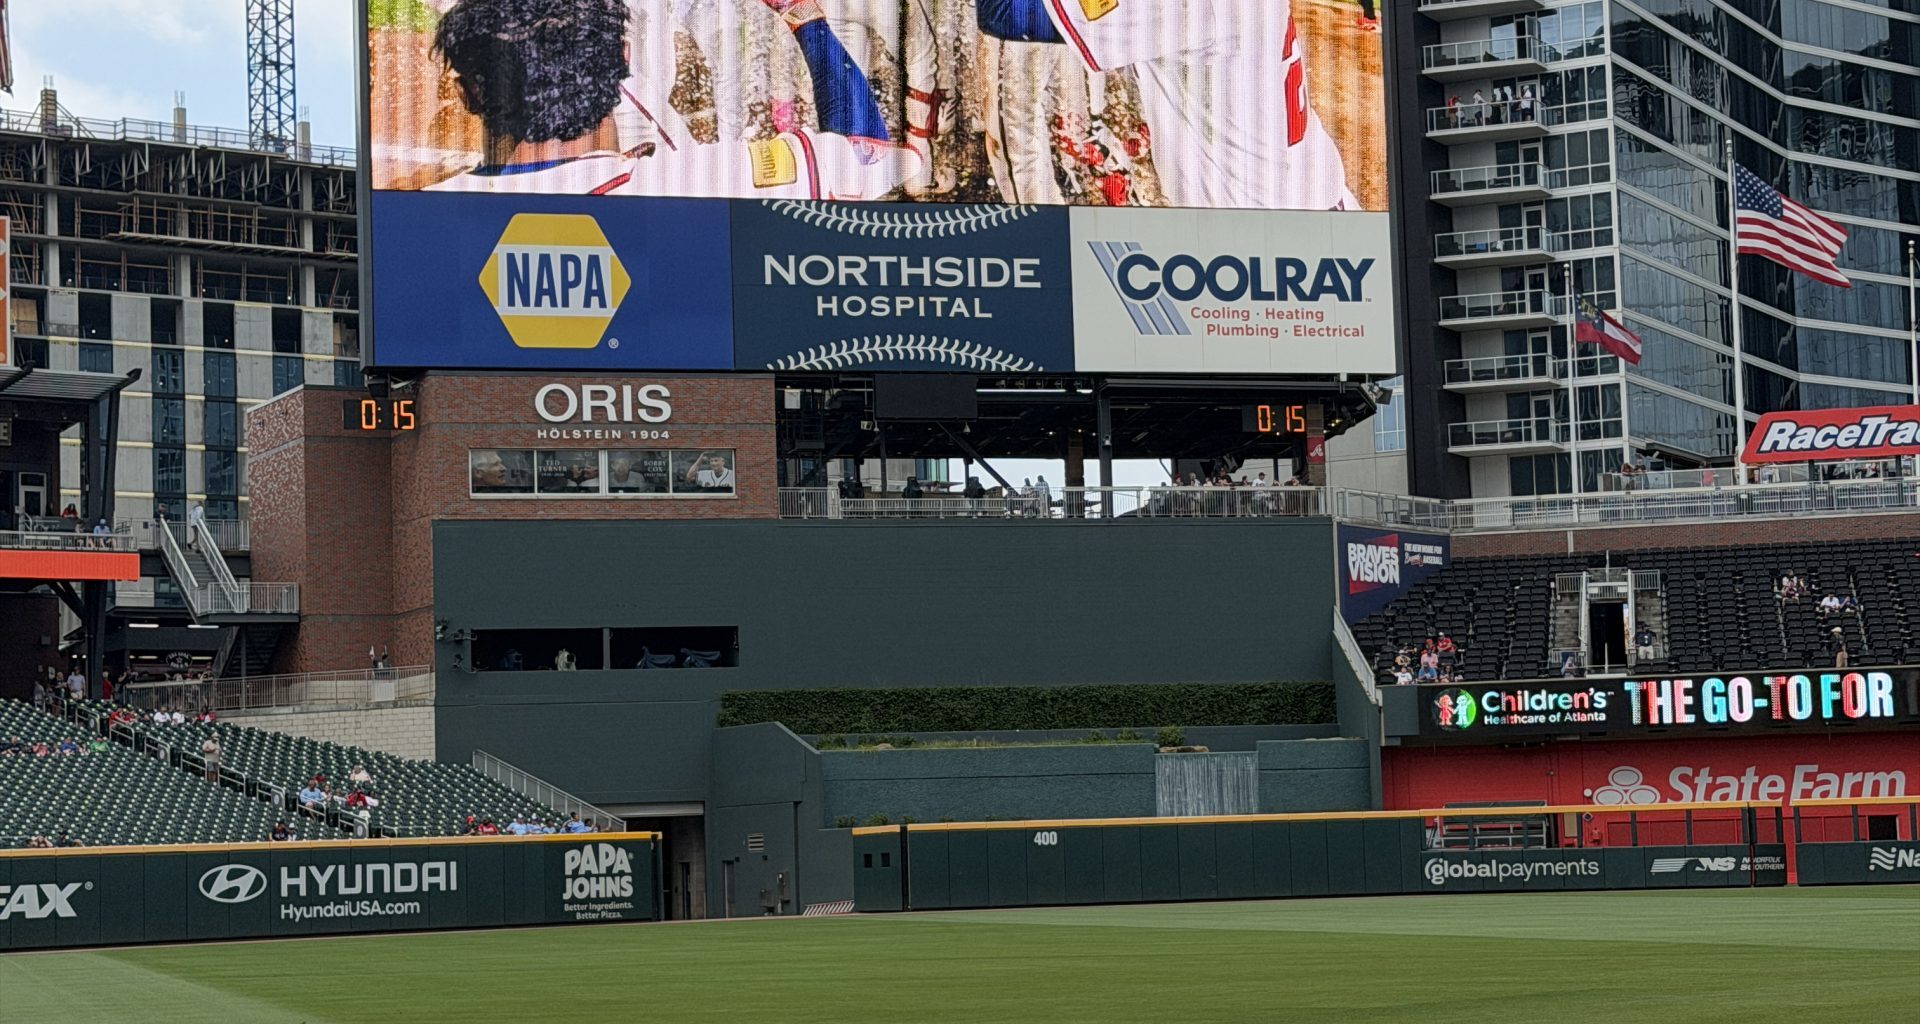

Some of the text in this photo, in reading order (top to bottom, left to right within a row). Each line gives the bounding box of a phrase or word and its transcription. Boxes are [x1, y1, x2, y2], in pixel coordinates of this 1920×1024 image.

[506, 252, 607, 309] NAPA
[764, 254, 1042, 288] NORTHSIDE
[1117, 253, 1376, 302] COOLRAY
[816, 295, 993, 318] HOSPITAL
[1190, 306, 1324, 322] Cooling Heating
[1206, 324, 1365, 339] Plumbing Electrical
[361, 399, 415, 430] 0:15
[535, 383, 672, 422] ORIS
[1257, 404, 1305, 432] 0:15
[537, 427, 670, 439] HÖLSTEIN 1904
[1757, 414, 1920, 452] RaceTra
[1347, 543, 1399, 565] BRAVES
[1348, 561, 1400, 584] VISION
[1481, 687, 1607, 712] Children's
[1624, 679, 1696, 725] THE
[1702, 675, 1812, 723] GO-TO
[1820, 672, 1894, 719] FOR
[1484, 711, 1606, 725] Healthcare of Atlanta
[1033, 831, 1058, 846] 400
[564, 843, 632, 875] PAPA
[280, 861, 458, 897] HYUNDAI
[562, 875, 634, 900] JOHNS
[280, 900, 420, 922] HyundaiUSA.com
[564, 901, 634, 911] Better Ingredients.
[576, 910, 623, 920] Better Pizza.
